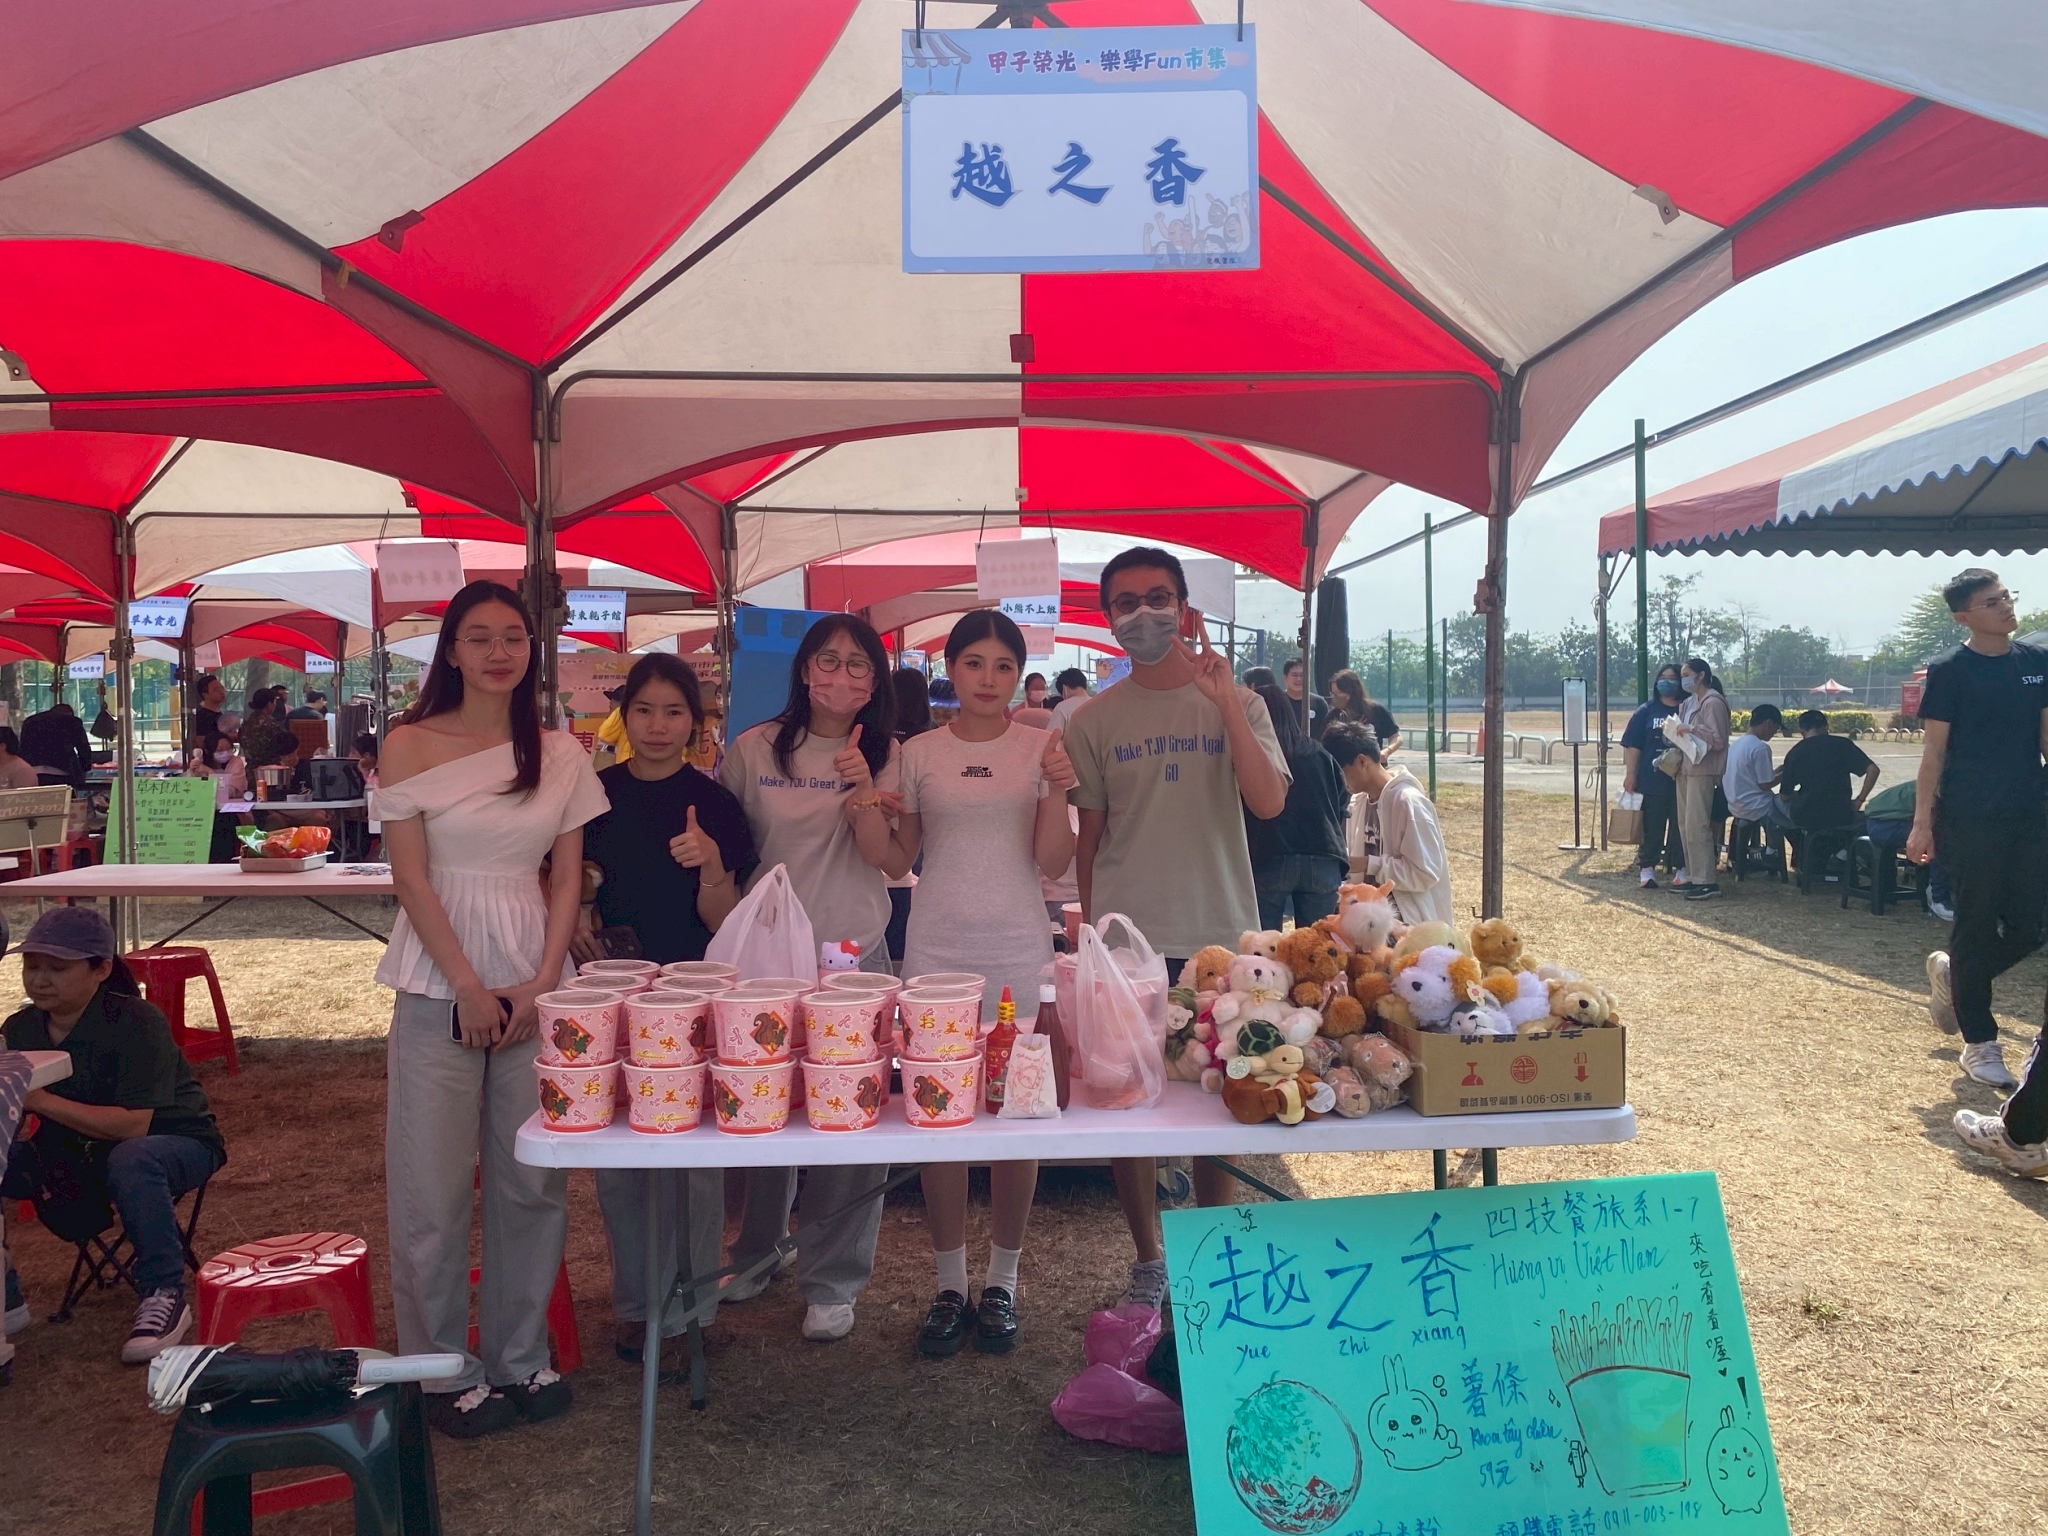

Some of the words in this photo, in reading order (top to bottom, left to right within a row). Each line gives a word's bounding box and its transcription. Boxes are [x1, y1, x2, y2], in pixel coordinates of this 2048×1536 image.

[951, 138, 1206, 208] 越之香
[1002, 603, 1057, 614] 小熊不上班
[1114, 743, 1143, 763] Make
[1168, 734, 1199, 752] Great
[759, 776, 785, 788] Make
[809, 777, 836, 789] Great
[1165, 763, 1179, 782] 60
[1574, 1052, 1588, 1065] UP
[1520, 1093, 1571, 1105] ISO-9001
[1620, 1236, 1670, 1275] Nam
[1208, 1212, 1474, 1332] 越之香
[1233, 1344, 1271, 1375] yue
[1461, 1357, 1529, 1418] 薯條
[1479, 1460, 1518, 1489] 59元
